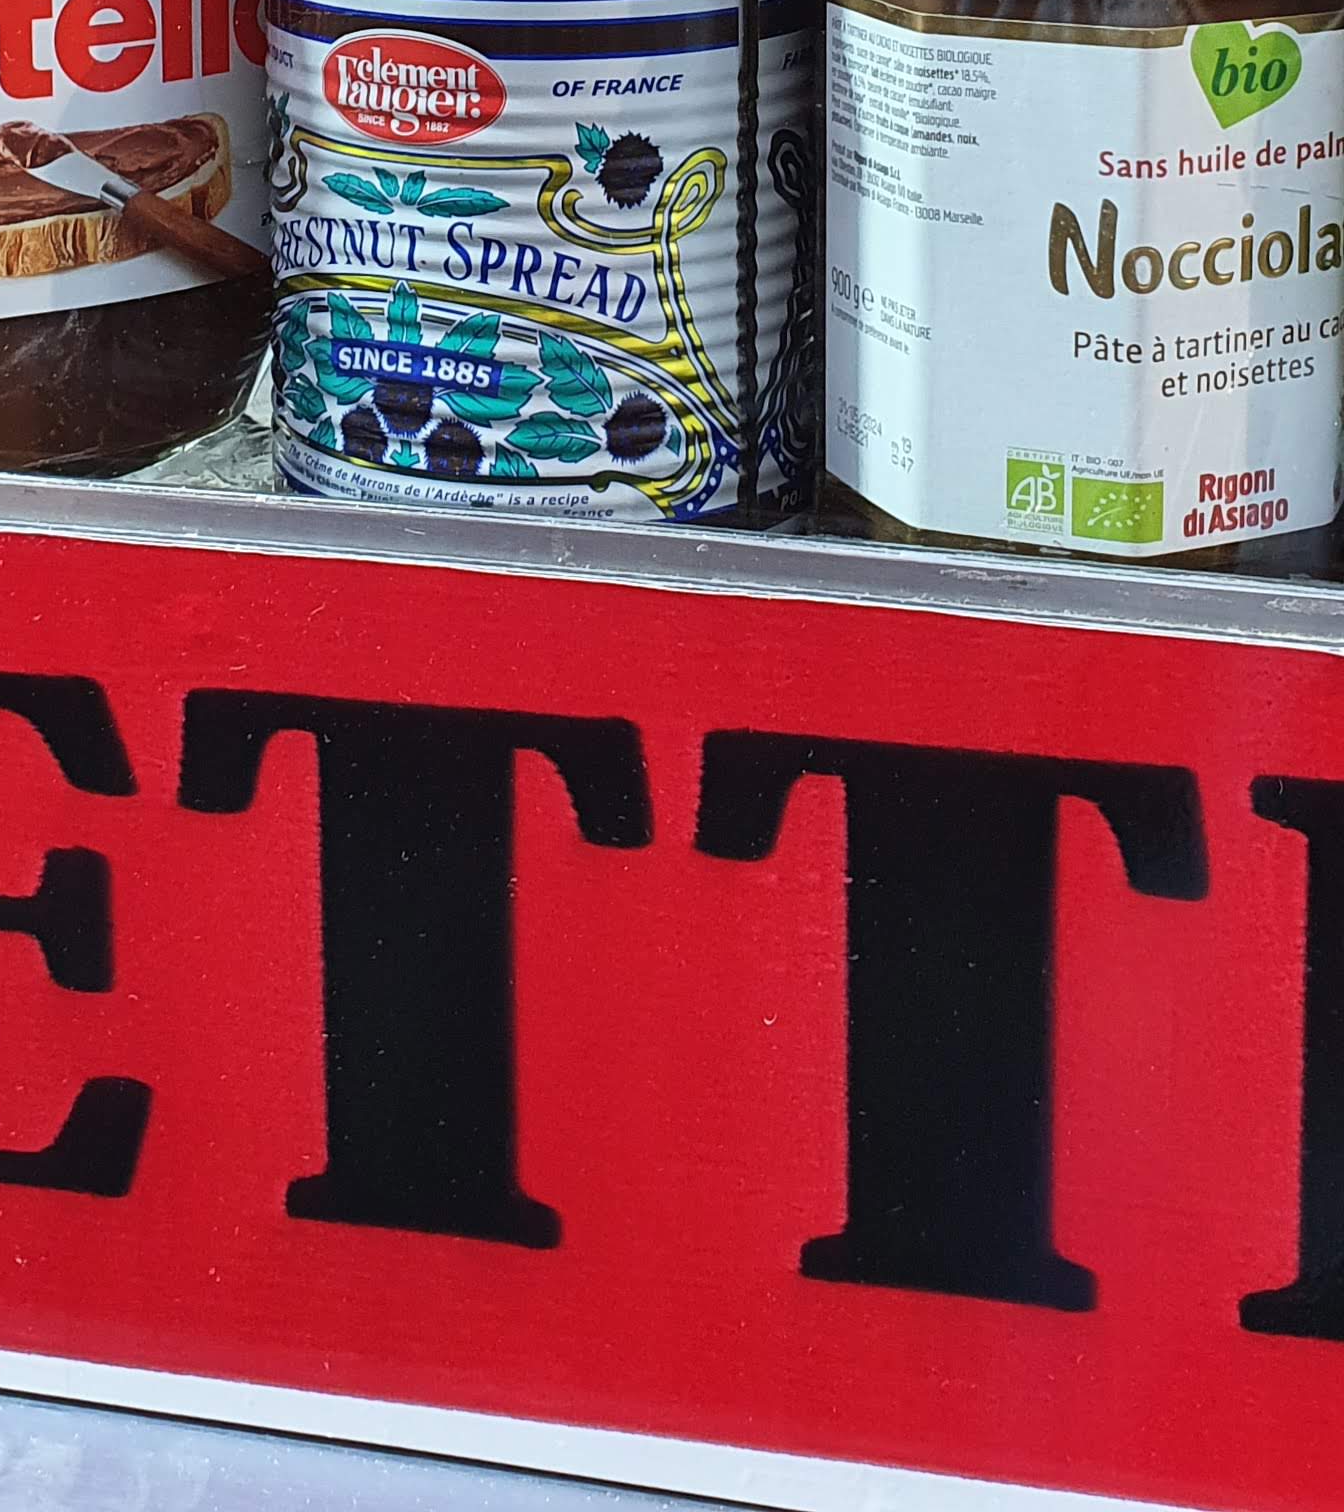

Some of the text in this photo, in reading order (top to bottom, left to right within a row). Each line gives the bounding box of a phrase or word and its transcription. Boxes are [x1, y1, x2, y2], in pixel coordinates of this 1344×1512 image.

[552, 73, 684, 98] OF FRANCE
[1211, 46, 1288, 98] bio
[937, 84, 998, 102] cacao maigre
[357, 113, 386, 127] SINCE
[1098, 150, 1168, 179] Sans
[1178, 144, 1246, 176] huile
[1255, 139, 1287, 167] de
[443, 221, 647, 325] SPREAD
[831, 265, 851, 300] 900
[902, 320, 932, 341] NATURE
[1073, 330, 1143, 364] Pâte
[1152, 336, 1166, 364] à
[1174, 325, 1275, 361] tartiner
[1281, 318, 1311, 346] au
[338, 345, 493, 390] SINCE 1885
[1161, 355, 1316, 398] et noisettes
[334, 467, 348, 482] de
[350, 471, 400, 495] Marrons
[404, 483, 422, 498] de
[508, 492, 522, 507] is
[526, 495, 537, 507] a
[540, 493, 590, 511] recipe
[1071, 465, 1118, 478] Agriculture
[1153, 469, 1165, 479] UE
[1198, 467, 1276, 504] Rigoni
[1010, 475, 1058, 516] AB
[1182, 497, 1290, 538] di Asiago
